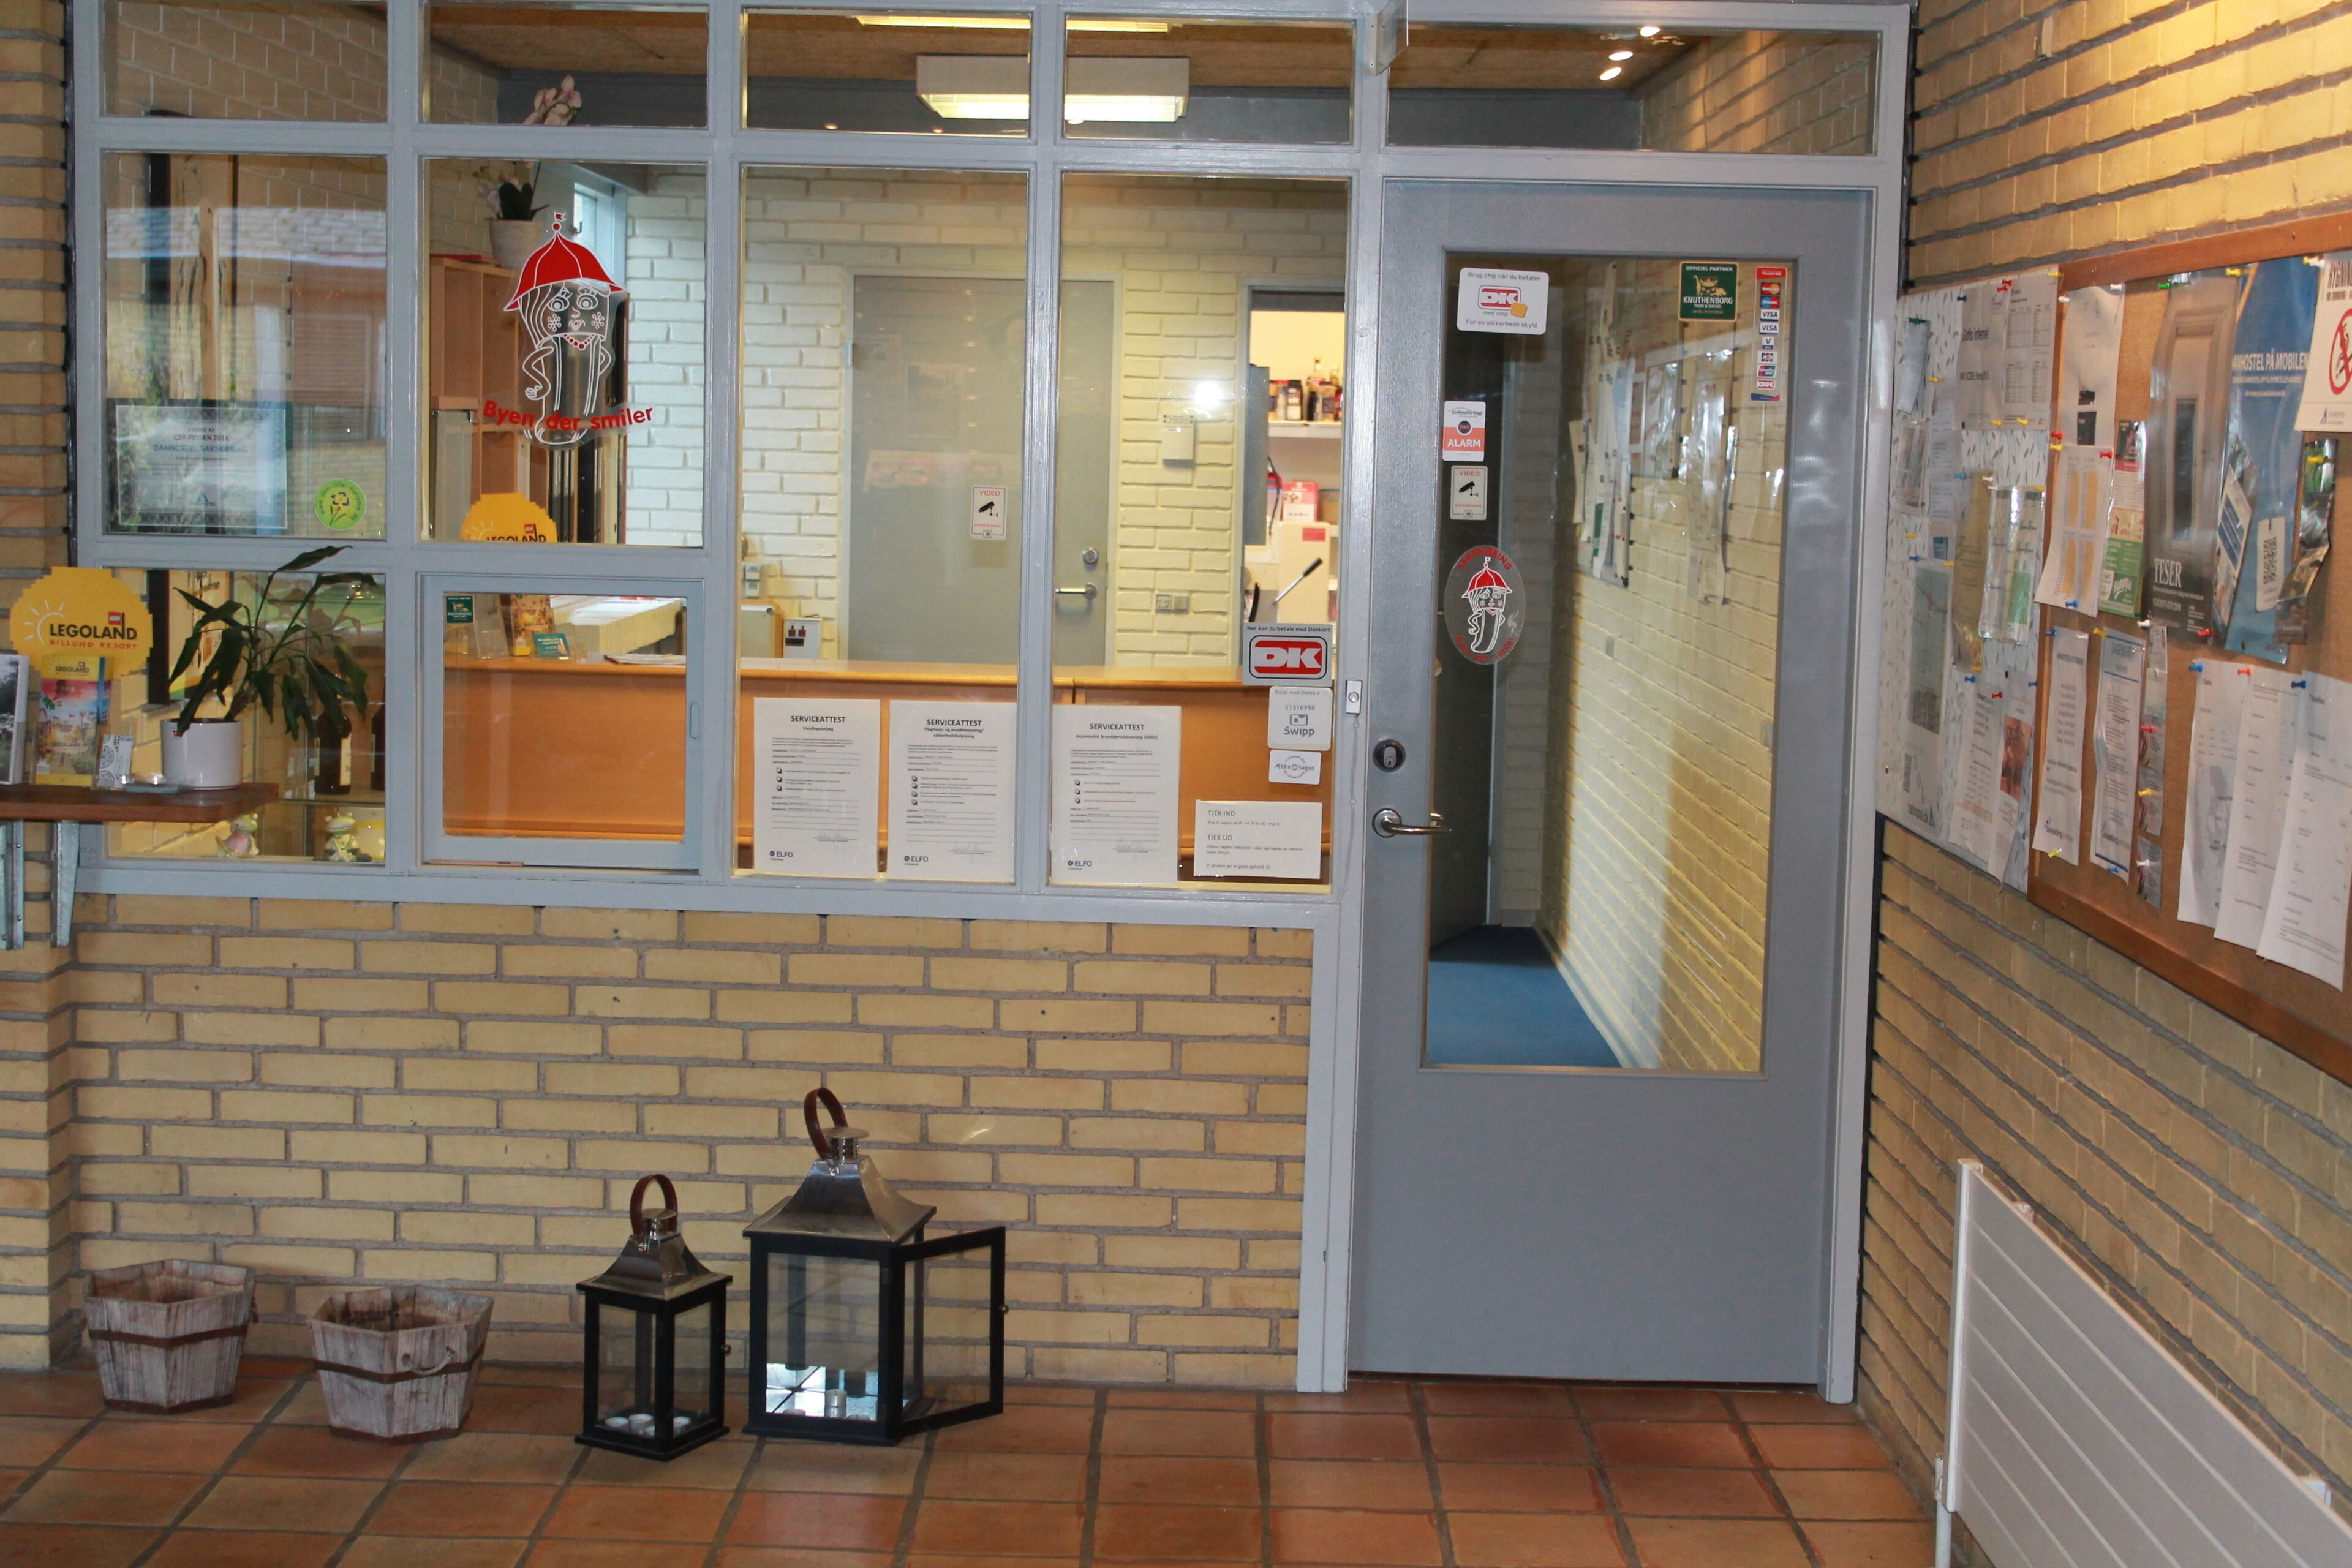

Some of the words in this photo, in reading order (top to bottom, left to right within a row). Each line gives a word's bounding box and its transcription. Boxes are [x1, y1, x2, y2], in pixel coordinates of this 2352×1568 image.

[1480, 291, 1518, 304] DK
[2266, 347, 2274, 371] PÅ
[483, 399, 535, 427] Byen
[546, 411, 581, 431] der
[590, 407, 653, 429] smiler
[1447, 439, 1481, 447] ALARM
[1457, 548, 1512, 570] SAKSKØBING
[2154, 558, 2182, 588] TESER
[50, 620, 138, 641] LEGOLAND
[49, 639, 94, 648] BILLUND
[1254, 647, 1322, 668] DK
[1284, 726, 1315, 737] Swipp
